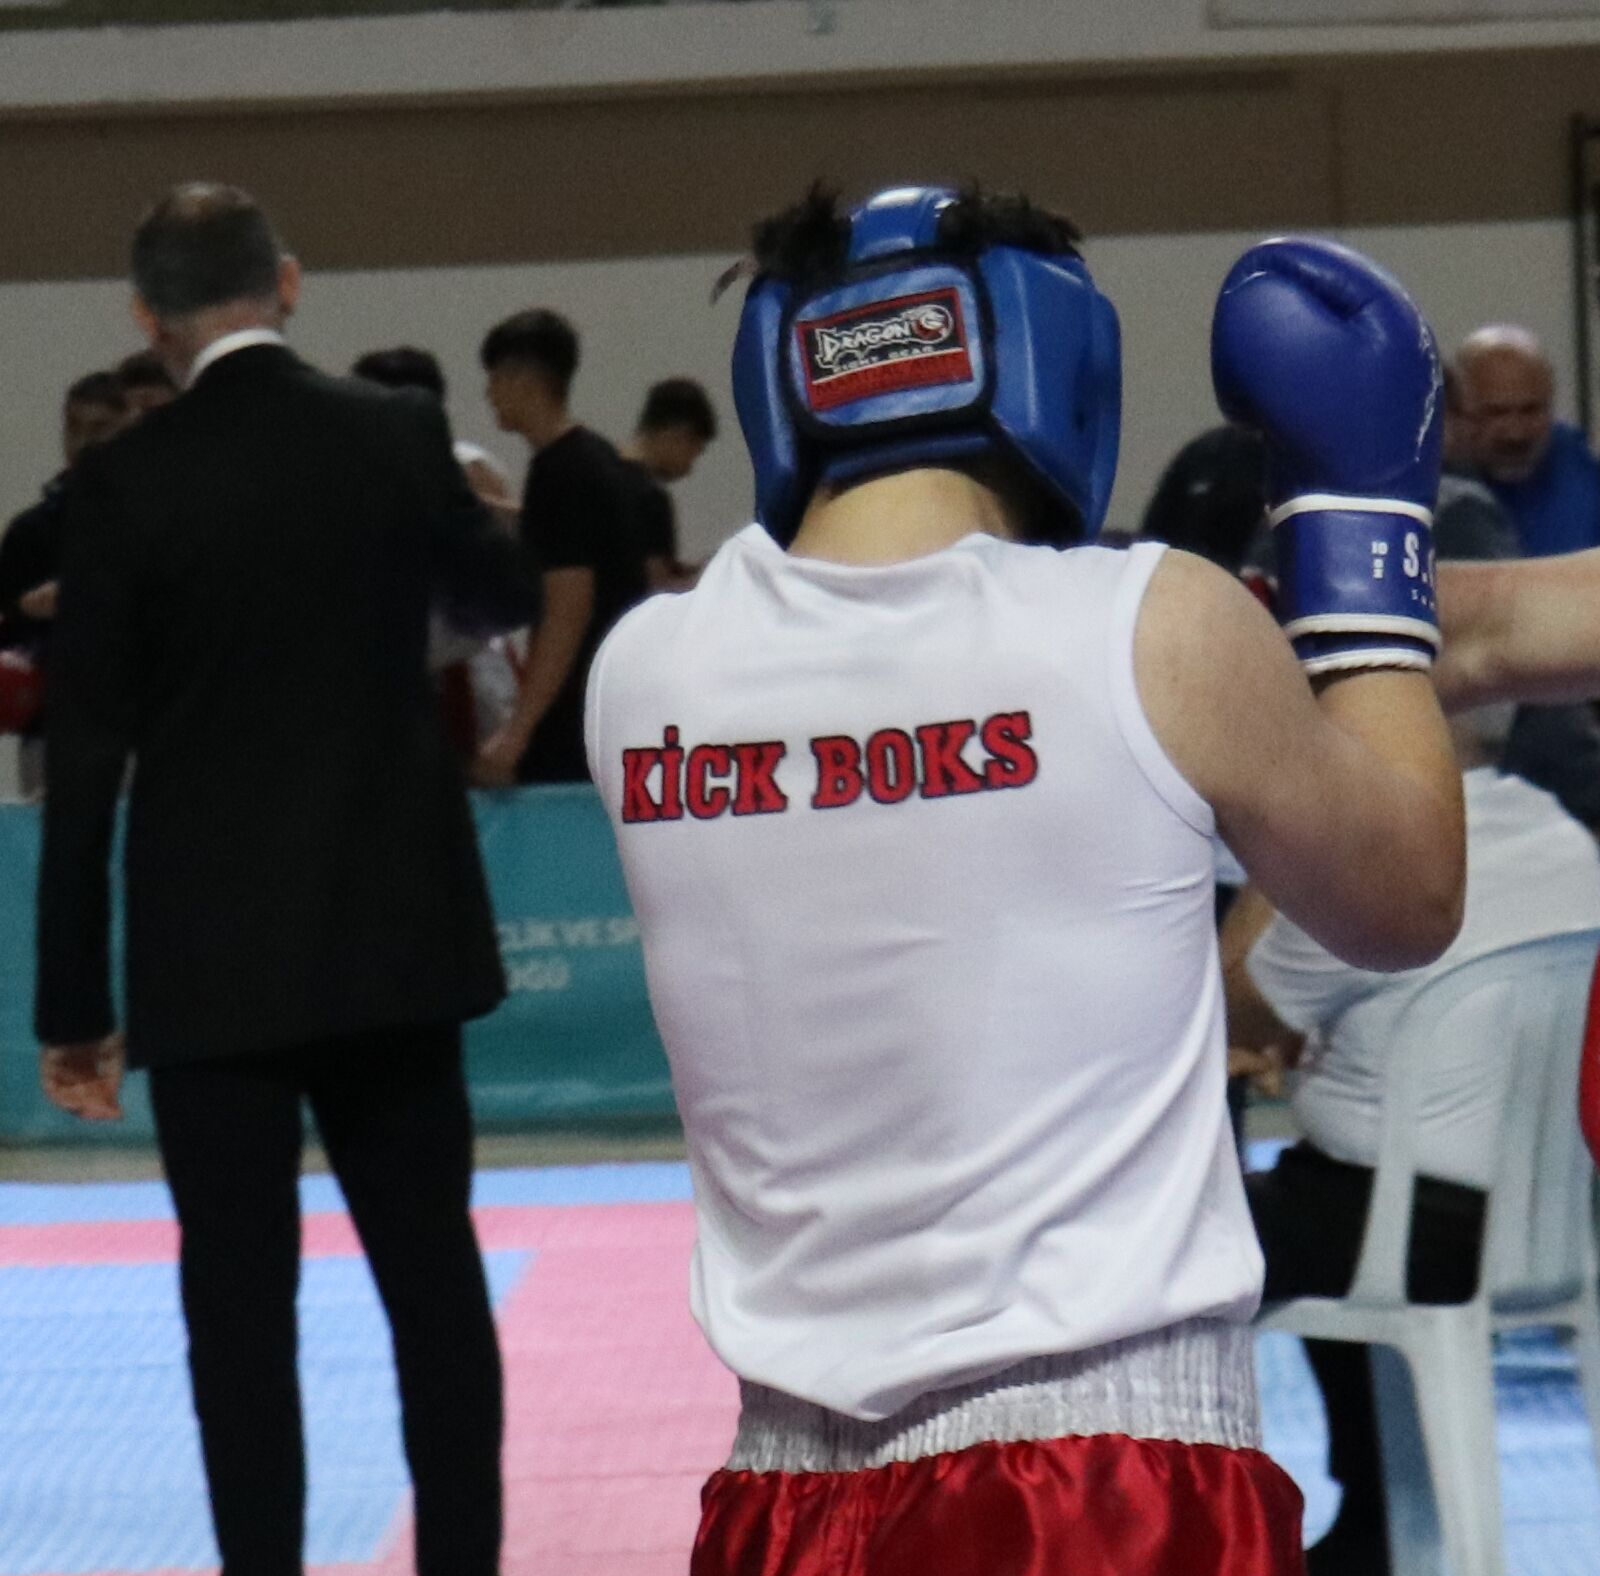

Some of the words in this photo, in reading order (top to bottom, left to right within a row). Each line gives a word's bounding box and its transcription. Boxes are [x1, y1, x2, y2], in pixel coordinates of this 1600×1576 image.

[819, 319, 913, 365] DRAGON
[622, 725, 788, 823] KİCK
[810, 711, 1039, 809] BOKS
